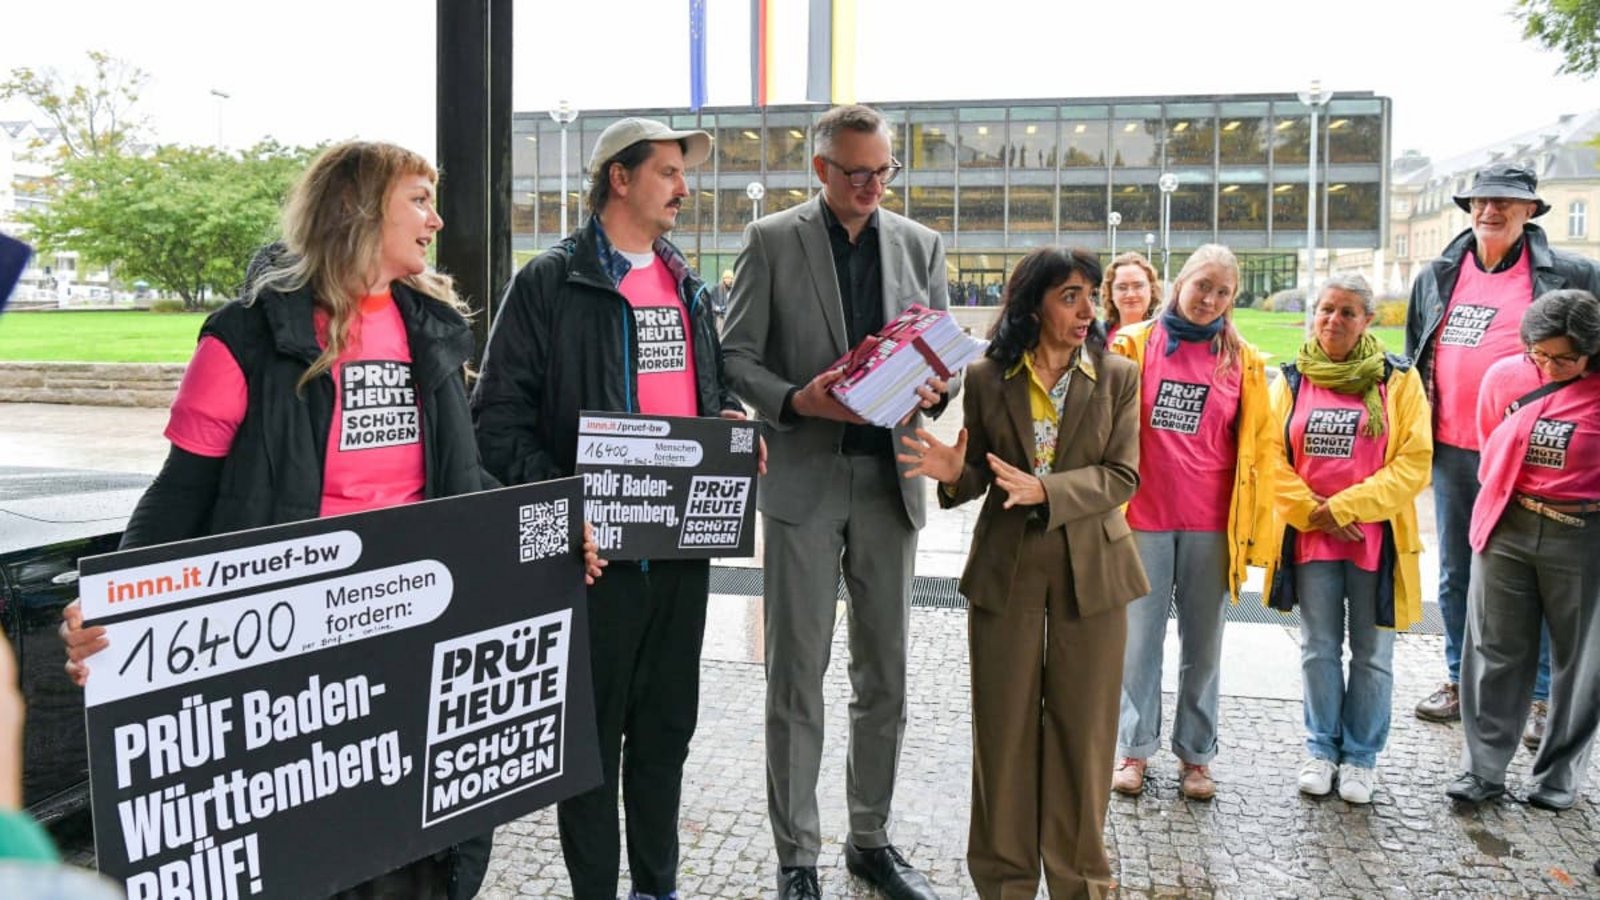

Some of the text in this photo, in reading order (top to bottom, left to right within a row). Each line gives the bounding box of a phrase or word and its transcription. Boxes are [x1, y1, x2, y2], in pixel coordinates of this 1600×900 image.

[633, 308, 679, 326] PRÜF
[1452, 305, 1496, 320] PRÜF
[1448, 316, 1490, 328] HEUTE
[637, 326, 683, 341] HEUTE
[345, 362, 411, 389] PRÜF
[345, 387, 414, 408] HEUTE
[1160, 382, 1207, 399] PRÜF
[1157, 394, 1202, 411] HEUTE
[347, 411, 415, 429] SCHÜTZ
[1152, 418, 1195, 431] MORGEN
[1154, 409, 1197, 423] SCHÜTZ
[1310, 410, 1360, 423] PRÜF
[345, 427, 416, 445] MORGEN
[1307, 422, 1355, 434] HEUTE
[1533, 420, 1573, 436] RÜF
[655, 443, 697, 452] Menschen
[1306, 437, 1351, 447] SCHÜTZ
[1530, 433, 1567, 448] EUTE
[1305, 446, 1349, 455] MORGEN
[1525, 455, 1562, 466] ORGEN
[583, 469, 673, 497] PRÜF Baden-
[692, 480, 746, 498] PRÜF
[583, 499, 679, 527] Württemberg,
[690, 500, 742, 514] HEUTE
[686, 519, 739, 532] SCHÜTZ
[592, 522, 622, 549] RÜF!
[683, 533, 736, 544] MORGEN
[325, 571, 436, 609] Menschen
[325, 601, 414, 634] fordern:
[118, 601, 295, 683] 16.400
[440, 621, 562, 695] PRÜF
[437, 666, 559, 735] HEUTE
[114, 674, 386, 789] PRÜF Baden-
[434, 714, 556, 779] SCHÜTZ
[432, 744, 555, 813] MORGEN
[117, 729, 413, 863] Württemberg,
